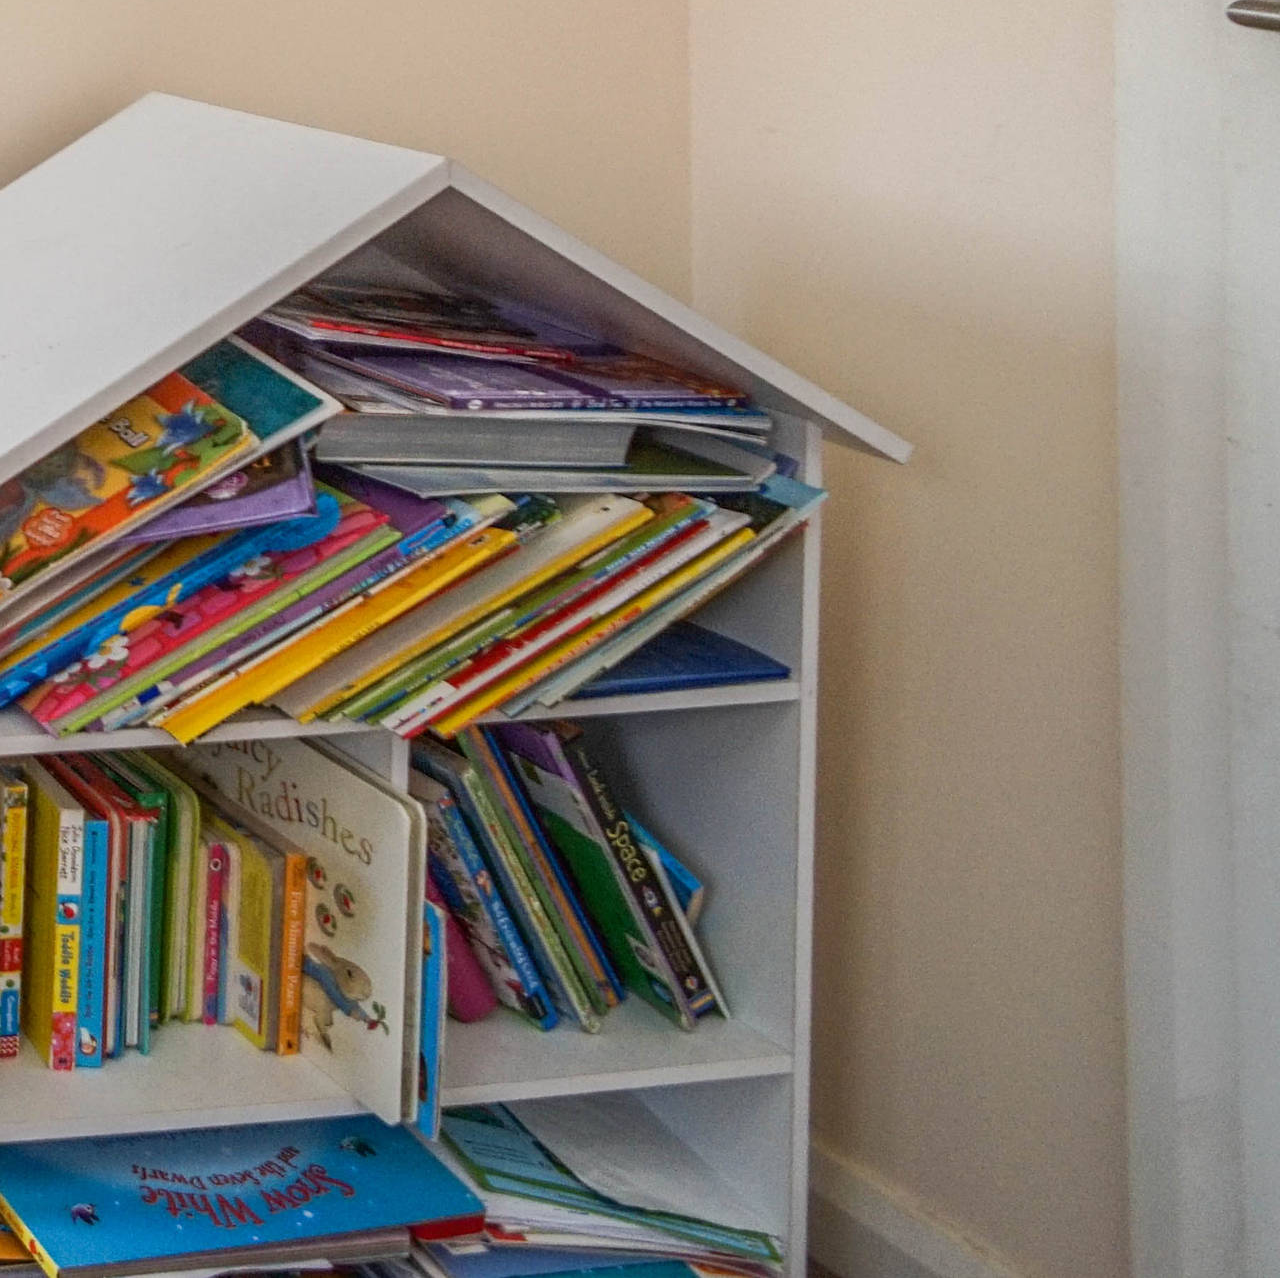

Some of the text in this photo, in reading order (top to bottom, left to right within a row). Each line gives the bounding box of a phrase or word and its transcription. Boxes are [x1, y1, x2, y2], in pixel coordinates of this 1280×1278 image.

[108, 417, 150, 448] Ball
[237, 766, 374, 866] Radishes
[606, 820, 648, 882] Space
[290, 891, 303, 916] Five
[58, 931, 75, 1004] Toddle Waddle
[287, 974, 300, 1008] Peace
[131, 1145, 300, 1190] and the Seven Dwarfs
[139, 1163, 355, 1229] Snow White
